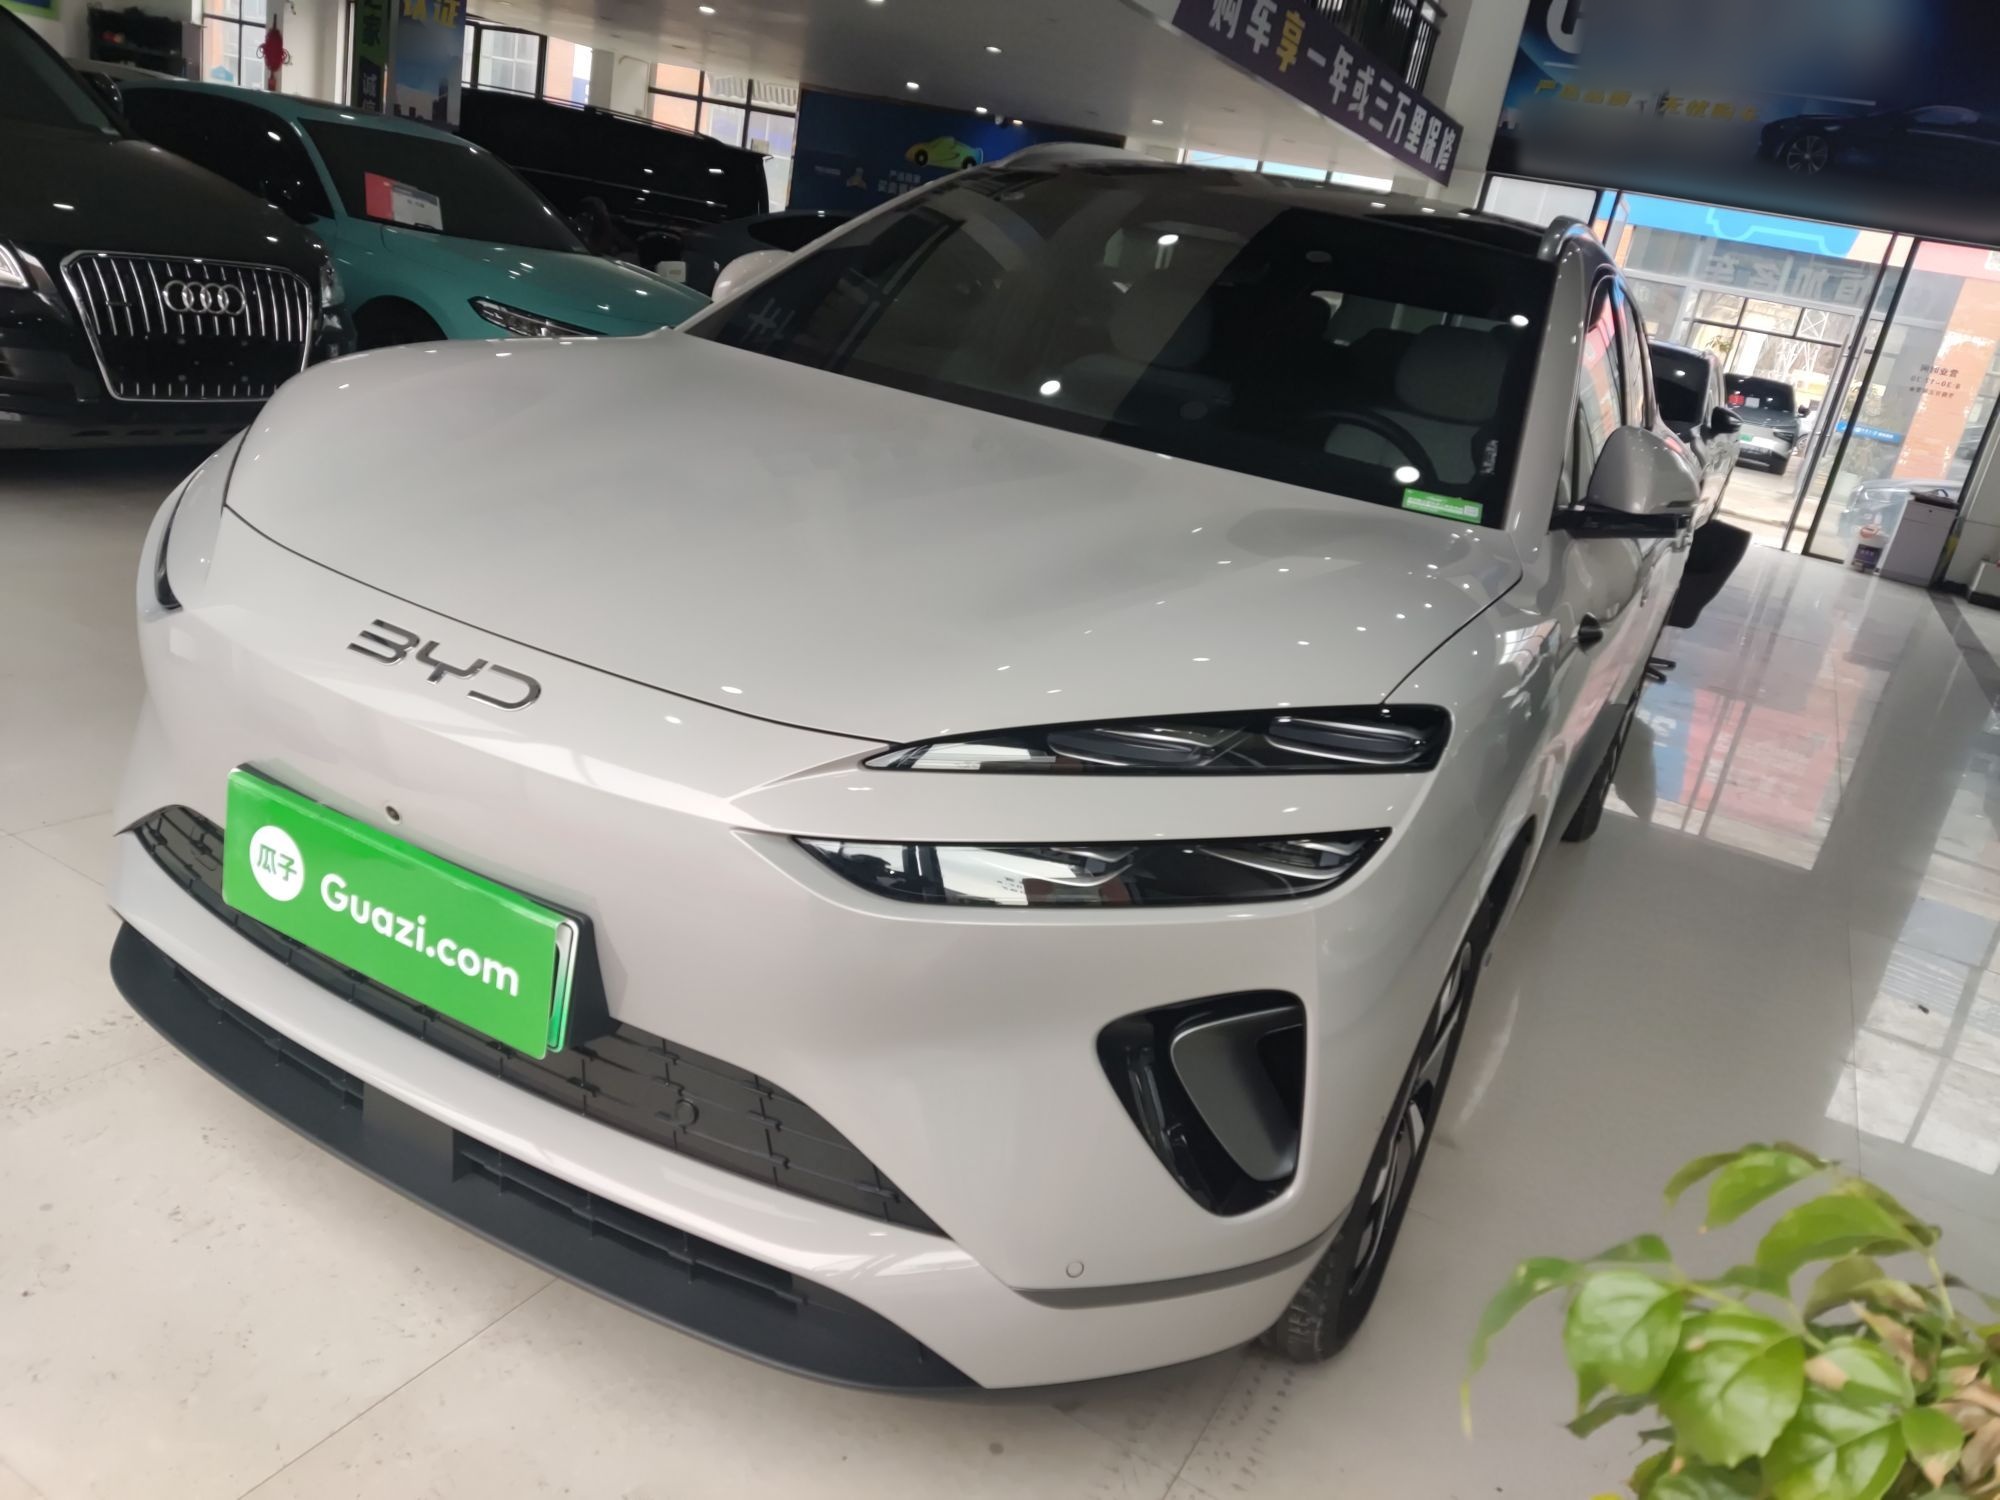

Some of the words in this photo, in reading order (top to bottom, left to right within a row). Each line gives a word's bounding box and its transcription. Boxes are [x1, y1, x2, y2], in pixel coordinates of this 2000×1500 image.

[346, 619, 542, 711] BYD
[256, 843, 298, 882] 瓜子
[319, 872, 520, 998] Guazi.com
